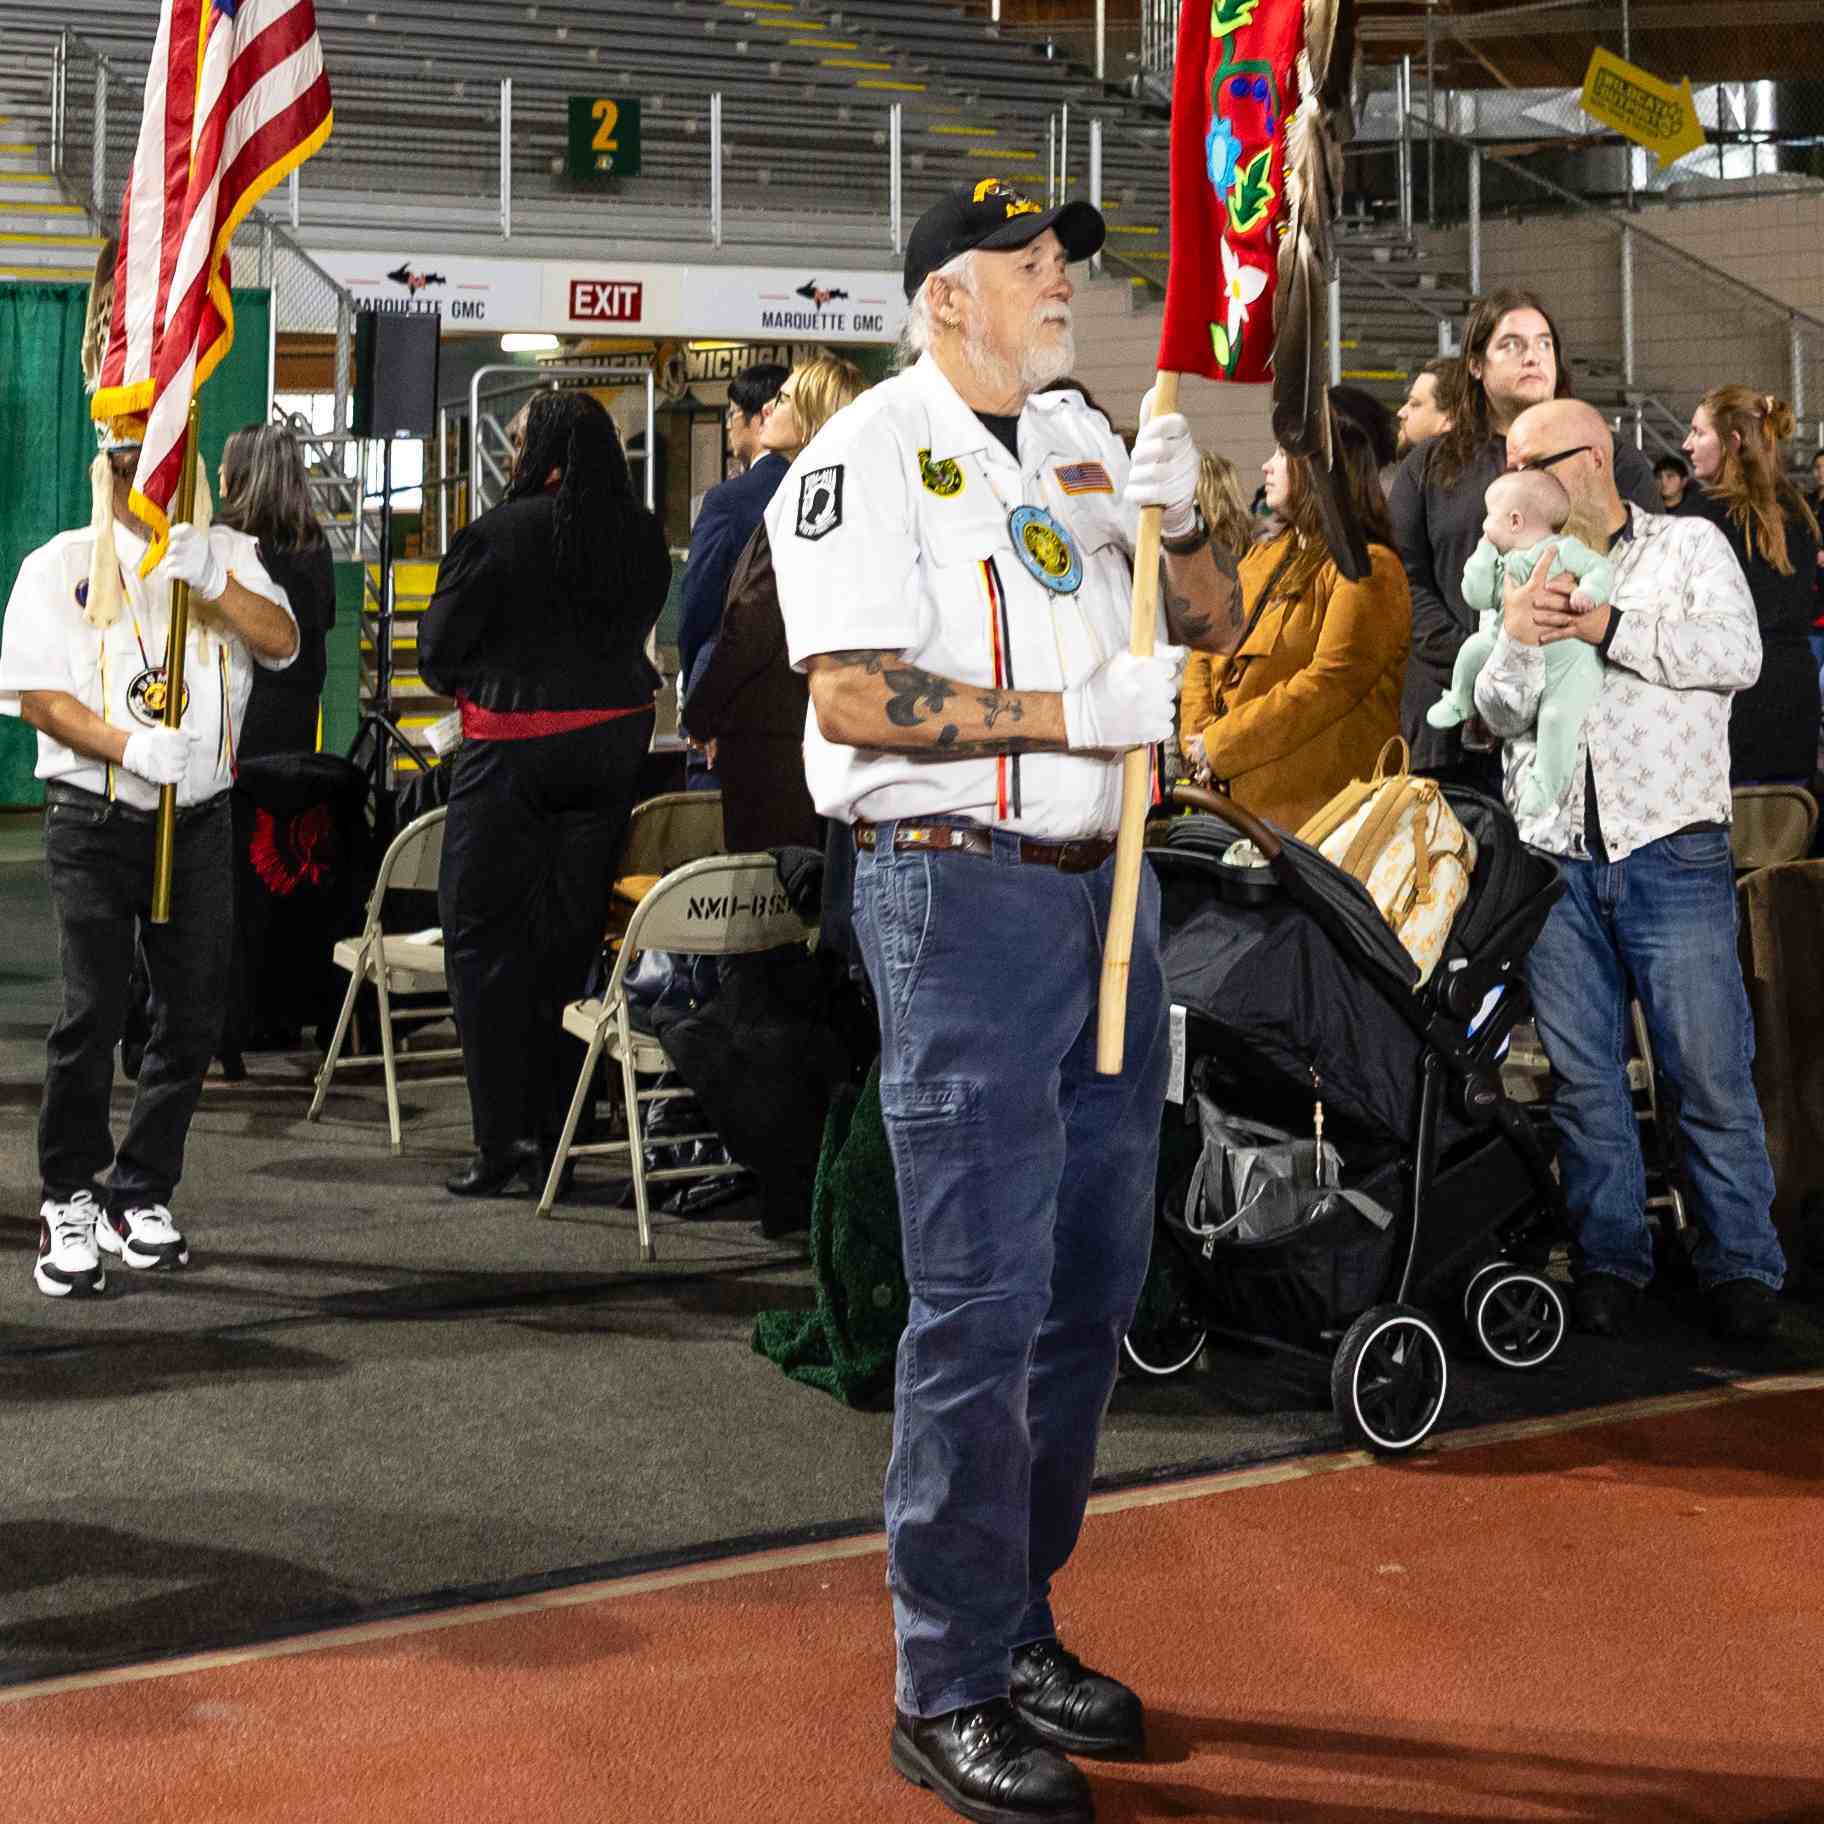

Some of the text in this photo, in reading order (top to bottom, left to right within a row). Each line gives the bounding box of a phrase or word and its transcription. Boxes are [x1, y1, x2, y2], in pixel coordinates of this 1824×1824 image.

[590, 98, 619, 151] 2
[451, 299, 486, 320] GMC
[575, 284, 638, 317] EXIT
[761, 310, 884, 333] MARQUETTE GMC
